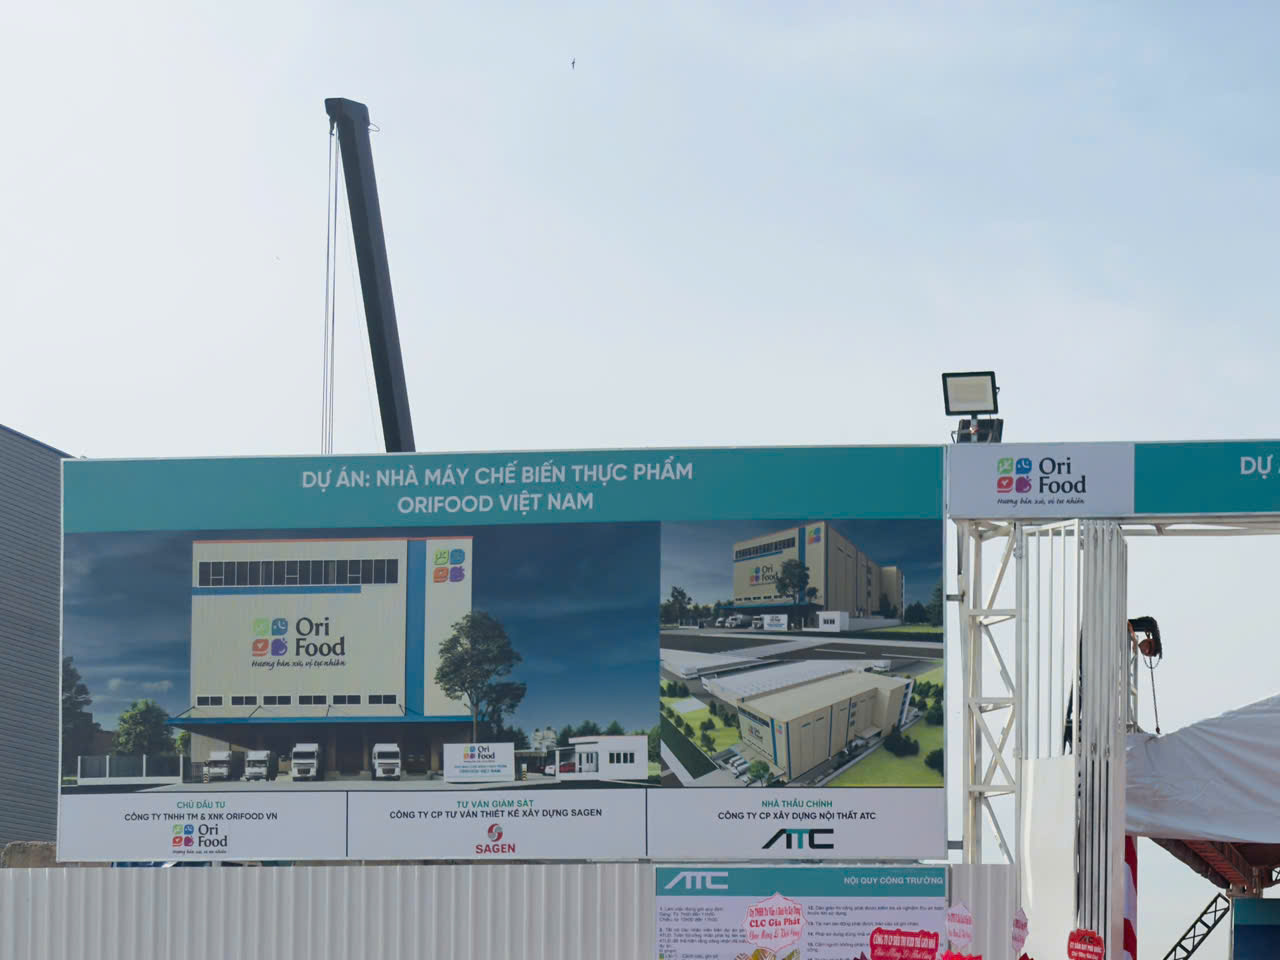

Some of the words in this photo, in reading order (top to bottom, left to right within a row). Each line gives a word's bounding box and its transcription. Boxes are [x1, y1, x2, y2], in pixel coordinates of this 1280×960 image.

[1039, 457, 1071, 474] Ori
[1240, 455, 1271, 479] DỰ
[302, 470, 330, 493] DỰ
[336, 467, 370, 488] ÁN:
[377, 465, 417, 487] NHÀ
[425, 464, 469, 485] MÁY
[475, 460, 516, 486] CHẾ
[523, 460, 566, 483] BIẾN
[571, 464, 626, 487] THỰC
[633, 455, 692, 480] PHẨM
[1039, 475, 1086, 493] Food
[398, 495, 493, 515] ORIFOOD
[499, 491, 541, 516] VIỆT
[548, 492, 592, 510] NAM
[296, 617, 329, 636] Ori
[296, 636, 345, 656] Food
[177, 800, 194, 809] CHỦ
[196, 800, 213, 809] ĐẦU
[457, 800, 469, 808] TƯ
[471, 799, 490, 808] VẤN
[492, 799, 514, 808] GIÁM
[517, 799, 534, 807] SÁT
[762, 799, 779, 808] NHÀ
[782, 798, 804, 808] THẦU
[806, 799, 832, 808] CHÍNH
[125, 812, 149, 821] CÔNG
[390, 810, 416, 819] CÔNG
[418, 811, 429, 819] TY
[431, 811, 442, 819] CP
[445, 810, 458, 818] TƯ
[460, 809, 478, 818] VẤN
[481, 809, 505, 818] THIẾT
[508, 808, 519, 818] KẾ
[522, 808, 539, 817] XÂY
[542, 809, 568, 818] DỰNG
[571, 809, 602, 817] SAGEN
[718, 810, 744, 820] CÔNG
[747, 812, 756, 820] TY
[759, 812, 771, 820] CP
[773, 810, 789, 820] XÂY
[792, 812, 816, 822] DỰNG
[819, 811, 835, 822] NỘI
[837, 810, 857, 820] THẤT
[860, 812, 876, 820] ATC
[198, 824, 218, 835] Ori
[198, 836, 227, 847] Food
[762, 829, 834, 849] ATC
[476, 844, 515, 854] SAGEN
[664, 872, 728, 889] ATC
[844, 876, 859, 885] NỘI
[861, 877, 878, 885] QUY
[880, 875, 904, 885] CÔNG
[907, 875, 943, 885] TRƯỜNG
[750, 920, 766, 928] CLC
[768, 919, 781, 927] Gia
